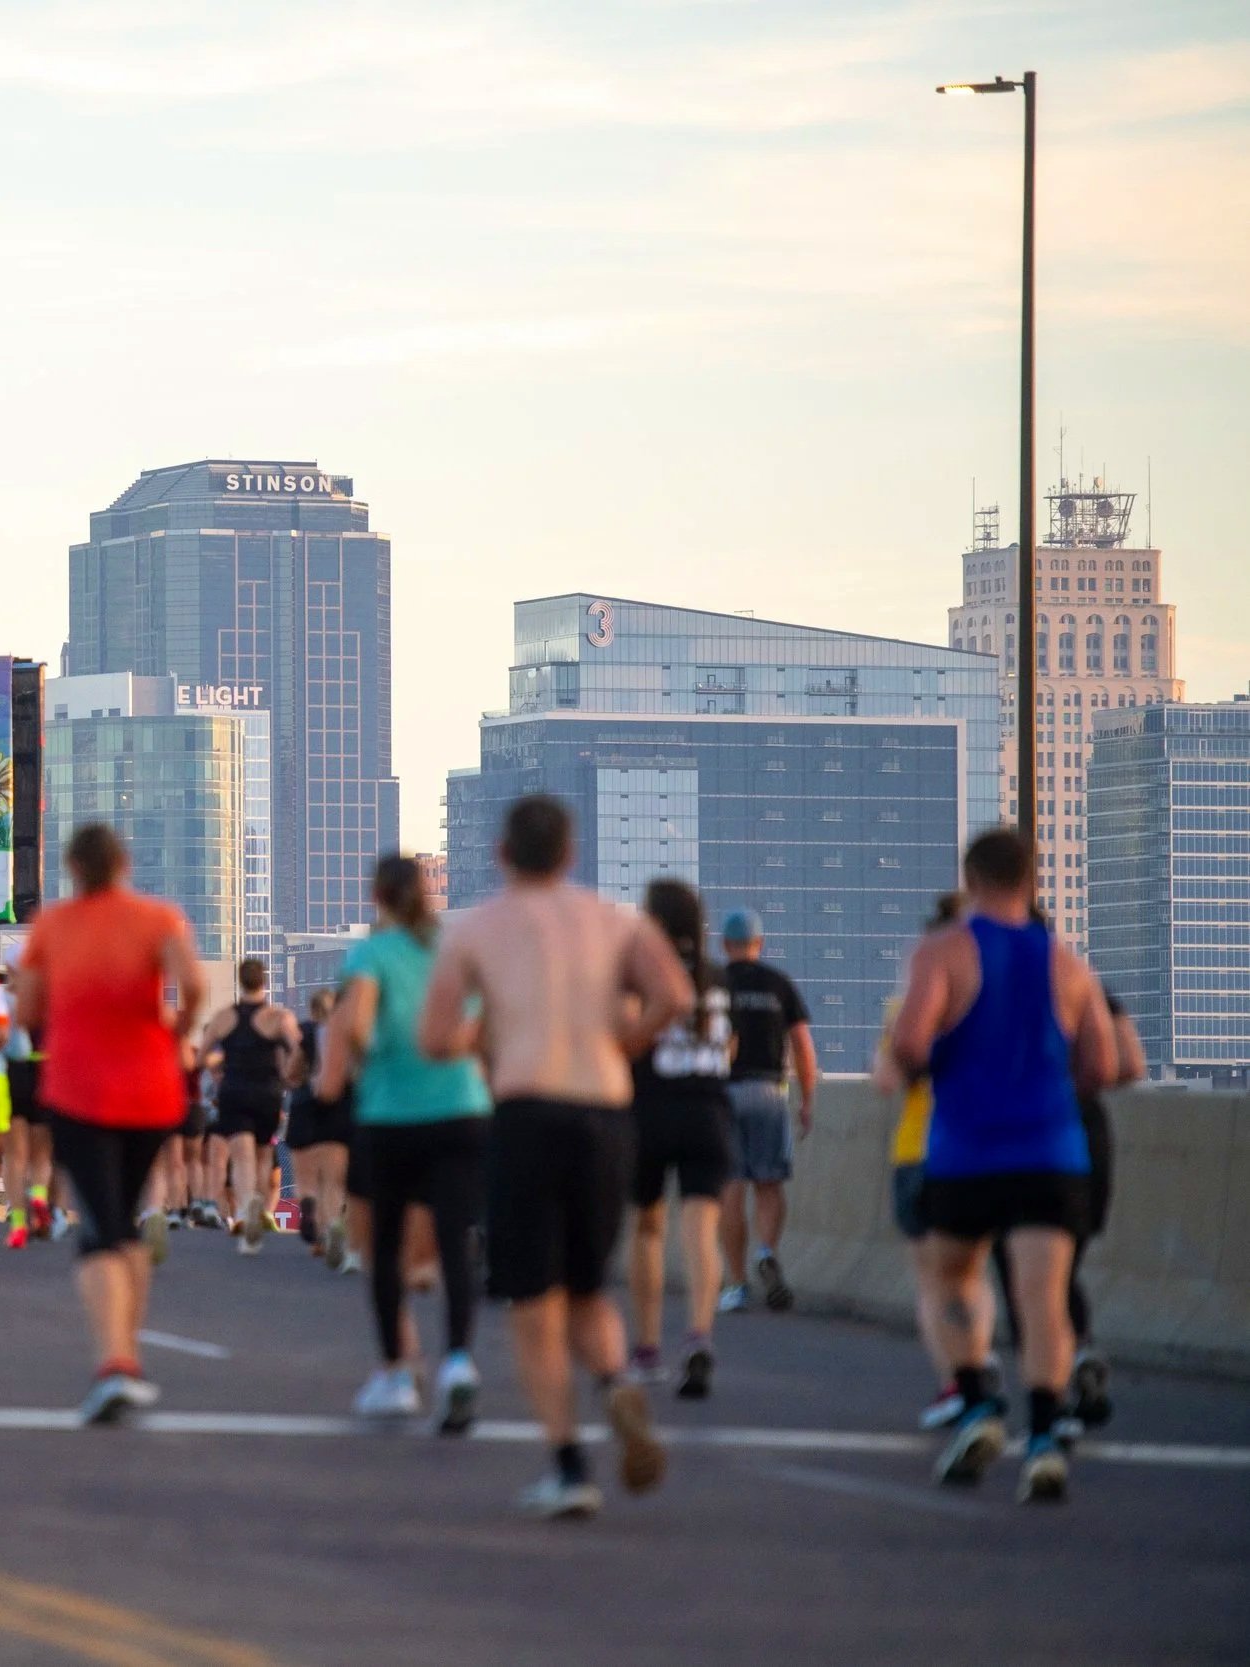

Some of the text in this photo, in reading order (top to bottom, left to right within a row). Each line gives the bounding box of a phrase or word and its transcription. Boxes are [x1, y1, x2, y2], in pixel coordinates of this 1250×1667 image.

[226, 473, 331, 493] STINSON
[586, 599, 615, 648] 3
[195, 685, 263, 706] LIGHT
